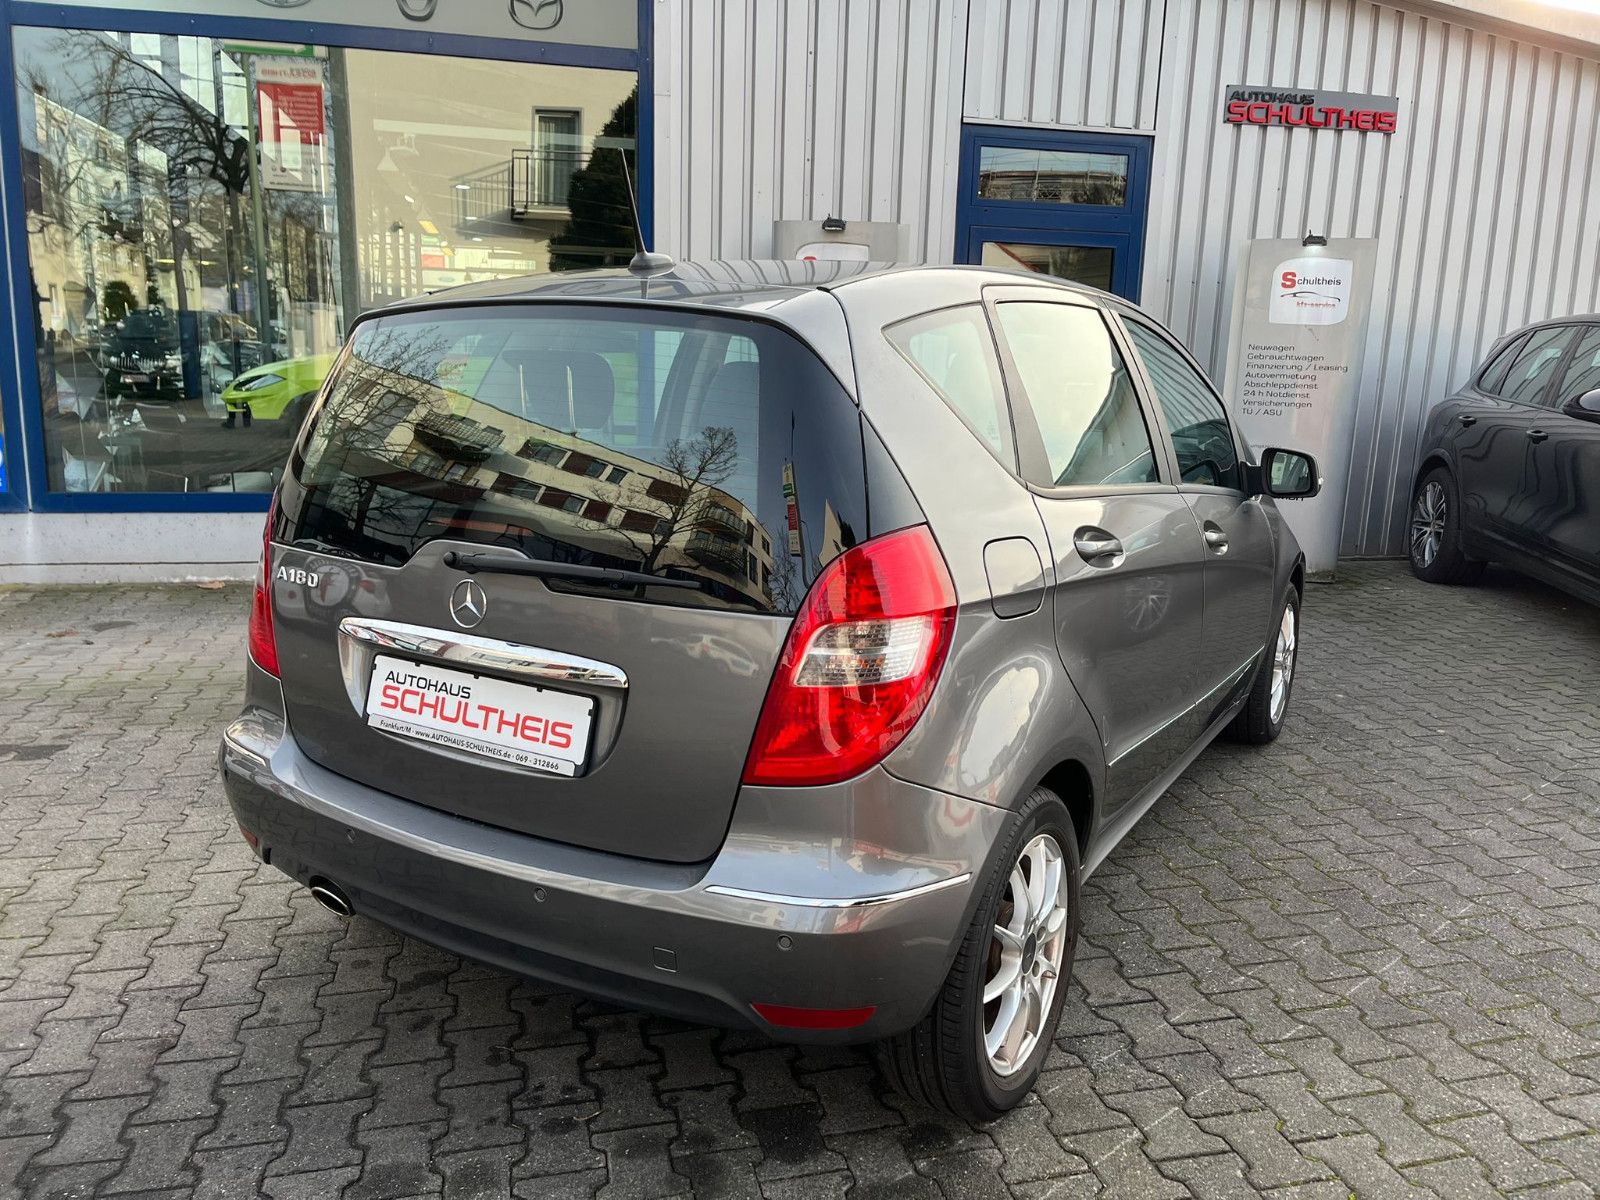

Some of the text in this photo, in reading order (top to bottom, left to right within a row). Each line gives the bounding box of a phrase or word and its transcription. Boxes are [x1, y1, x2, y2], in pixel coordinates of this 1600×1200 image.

[1229, 90, 1315, 105] AUTOHAUS
[1227, 100, 1396, 132] SCHULTHEIS
[1281, 271, 1342, 289] Schultheis
[1248, 344, 1295, 352] Neuwagen
[1247, 353, 1325, 362] Gebrauchtwagen
[1246, 362, 1303, 372] Finanzierung
[1313, 364, 1348, 373] Leasing
[1245, 371, 1317, 381] Autovermietung
[1244, 380, 1319, 390] Abschleppdienst
[1265, 390, 1311, 399] Notdienst
[1242, 399, 1313, 409] Versicherungen
[276, 565, 319, 588] A180
[385, 670, 472, 700] AUTOHAUS
[380, 684, 573, 749] SCHULTHEIS
[515, 753, 529, 763] 069
[534, 757, 559, 771] 312866
